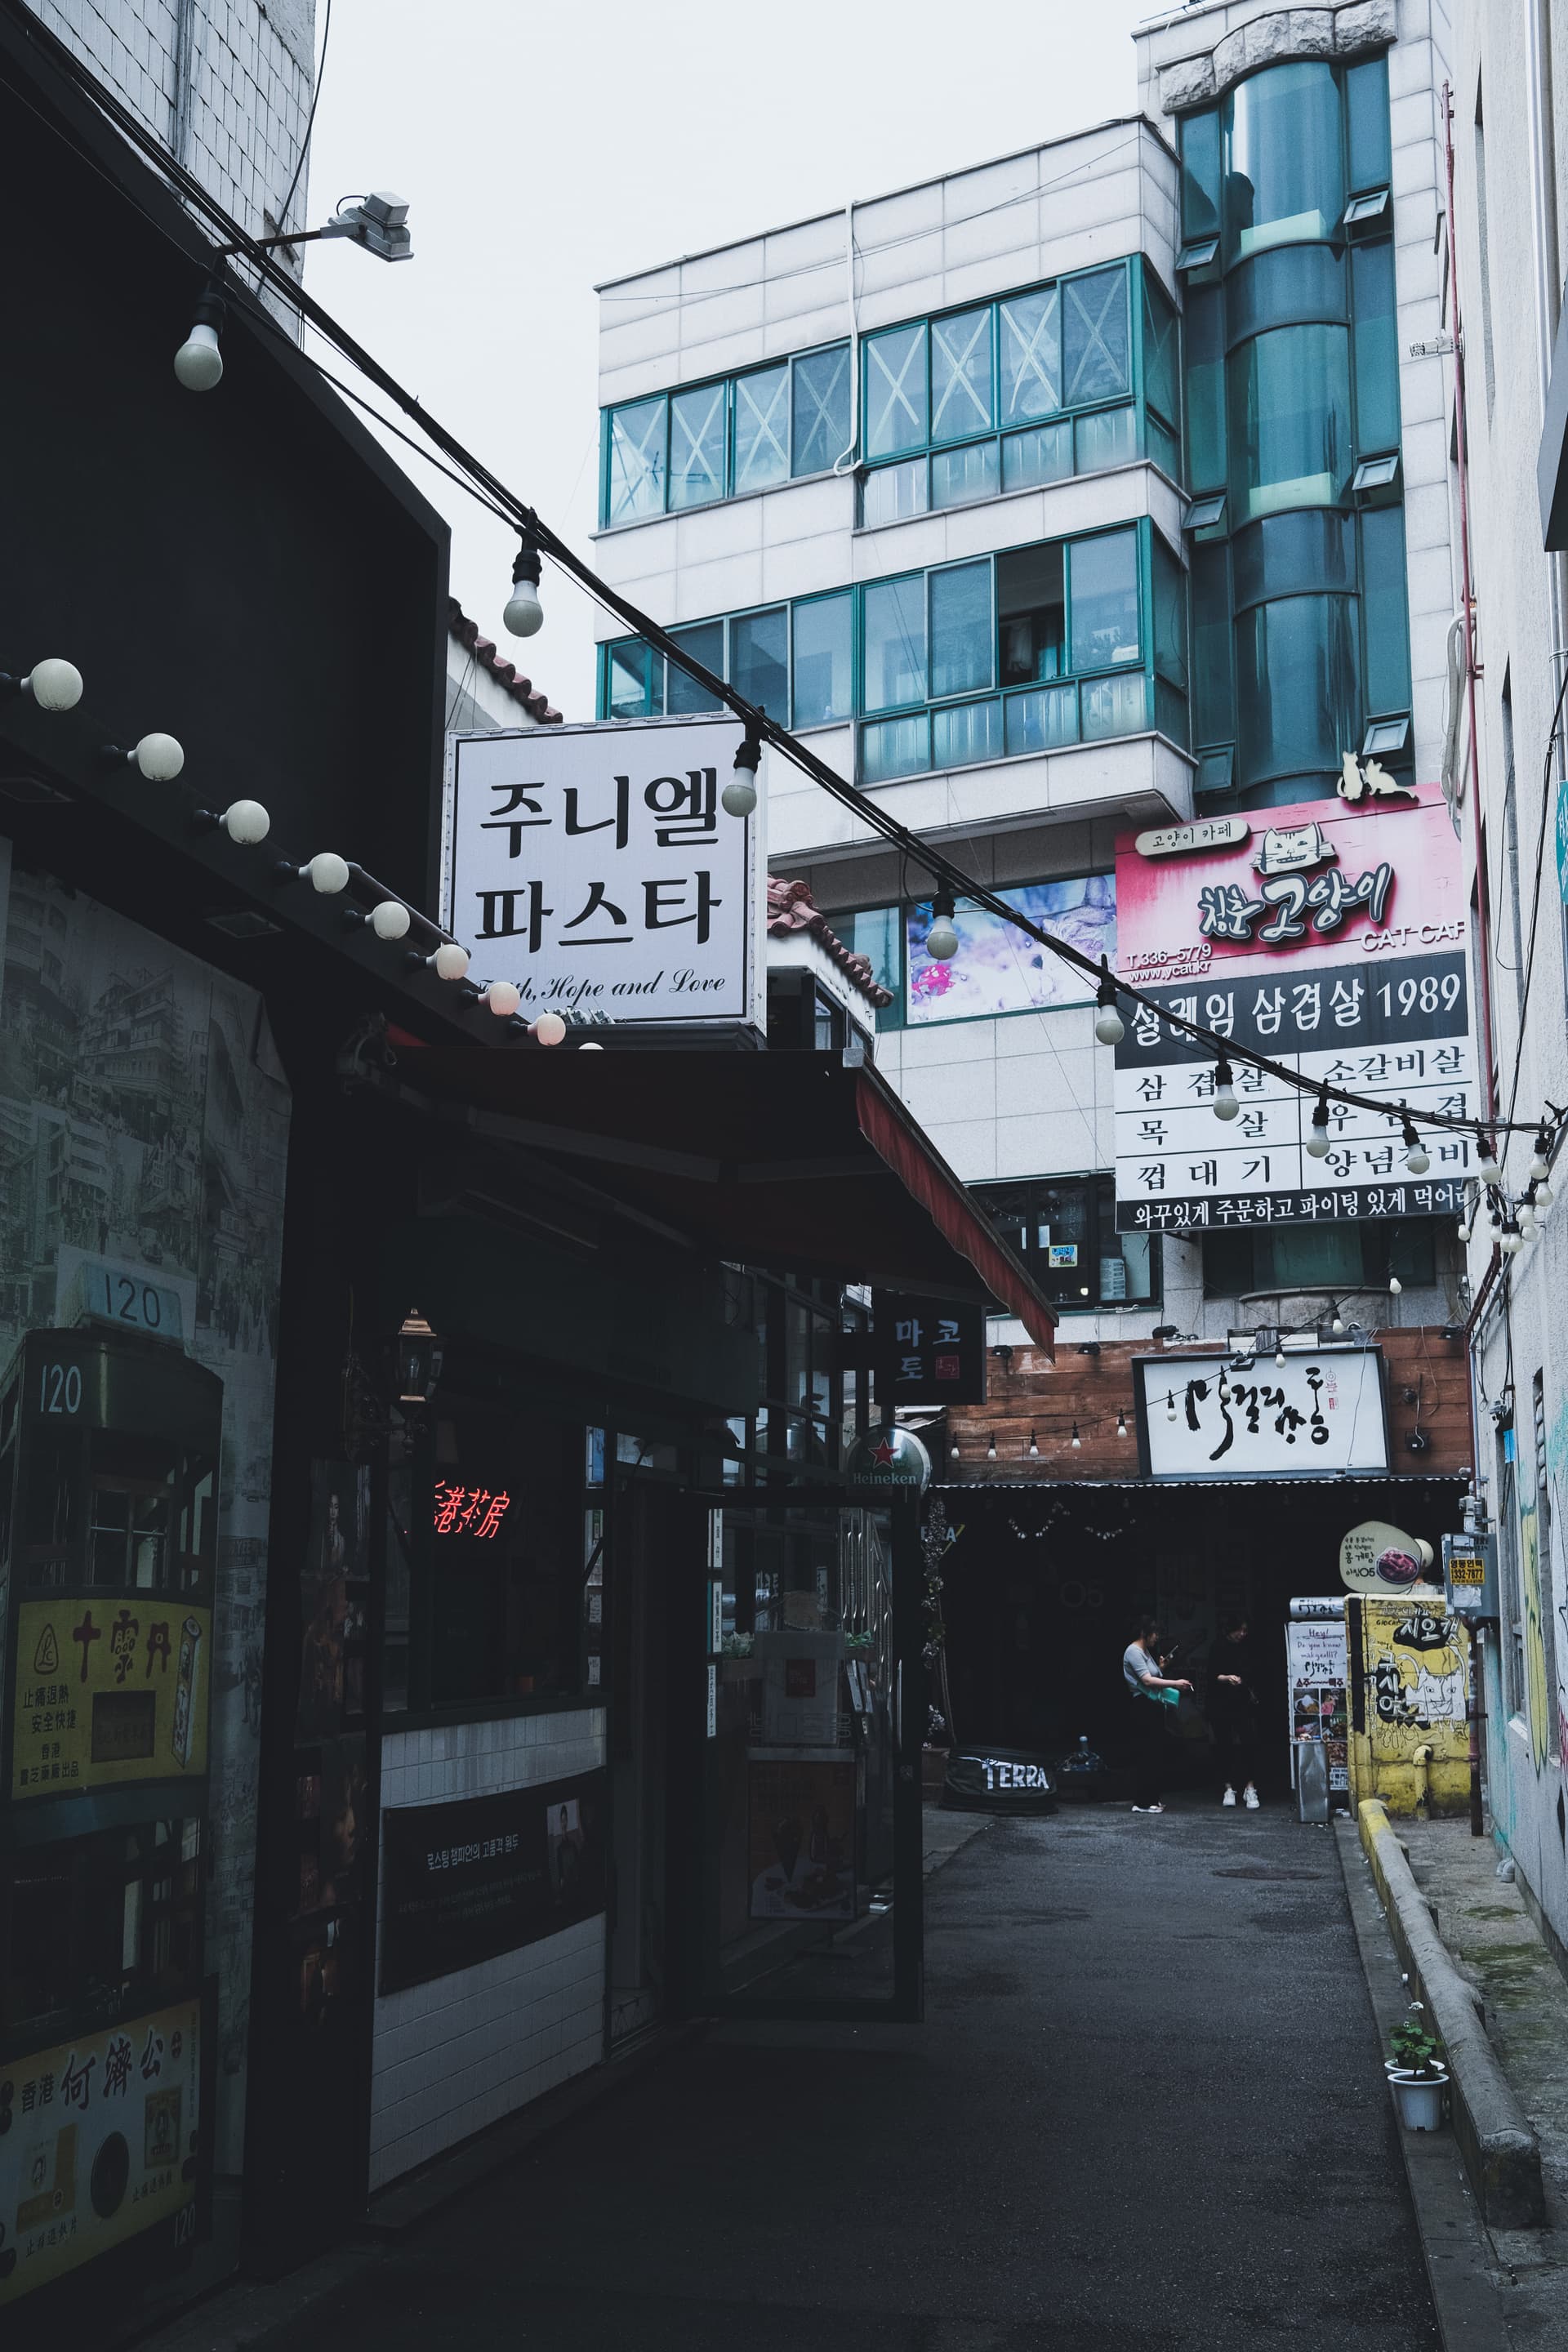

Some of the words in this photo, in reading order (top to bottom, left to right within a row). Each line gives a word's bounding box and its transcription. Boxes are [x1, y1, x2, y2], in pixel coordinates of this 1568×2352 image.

[480, 768, 719, 858] 주니엘
[1152, 827, 1194, 847] 고양이
[1202, 822, 1232, 840] 카페
[474, 871, 722, 953] 파스타
[1258, 862, 1394, 942] 고양이
[1361, 926, 1411, 951] CAT
[541, 974, 604, 1006] Hope
[612, 970, 664, 996] and
[669, 969, 725, 993] Love
[1129, 960, 1210, 982] www.ycat.kr
[1131, 992, 1234, 1046] 설레임
[1252, 978, 1364, 1034] 삼겹살
[1377, 973, 1461, 1018] 1989
[1324, 1046, 1465, 1084] 소갈비살
[1134, 1200, 1209, 1228] 와꾸있게
[1216, 1197, 1294, 1224] 주문하고
[1300, 1191, 1358, 1218] 파이팅
[1367, 1187, 1405, 1215] 있게
[105, 1274, 160, 1327] 120
[41, 1365, 82, 1414] 120
[853, 1472, 917, 1485] Heineken
[982, 1760, 1049, 1790] TERRA
[427, 1849, 450, 1870] 로스팅
[505, 1833, 519, 1853] 원두
